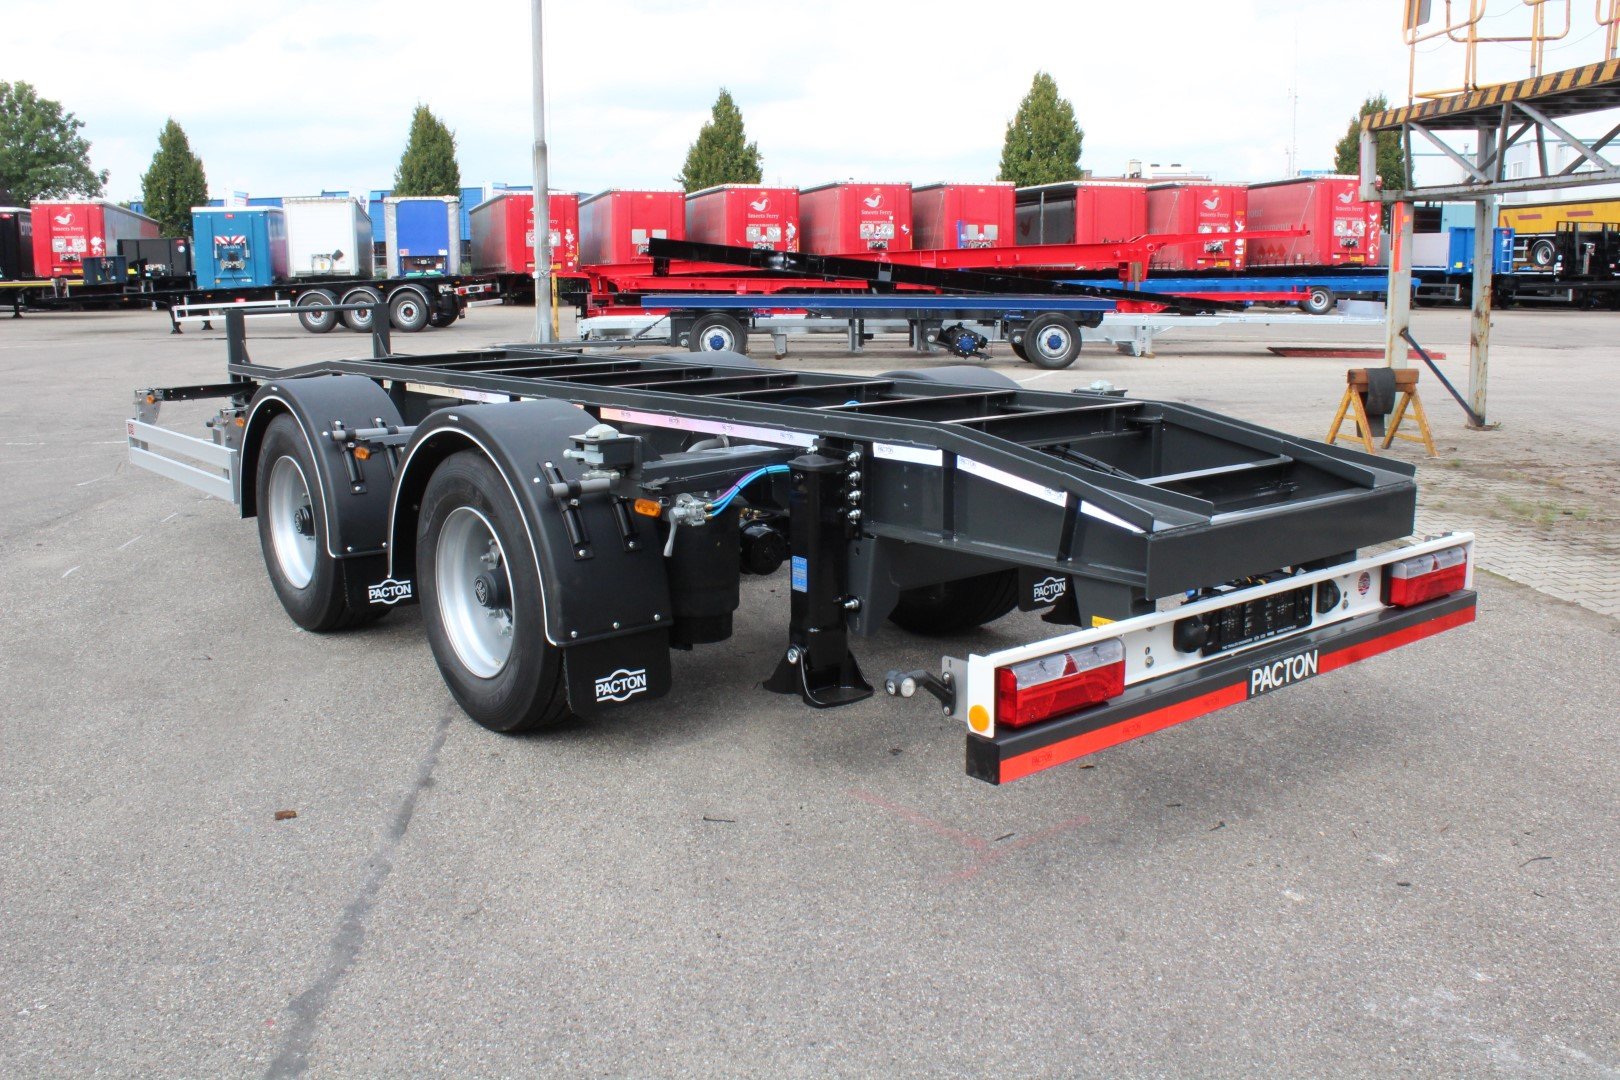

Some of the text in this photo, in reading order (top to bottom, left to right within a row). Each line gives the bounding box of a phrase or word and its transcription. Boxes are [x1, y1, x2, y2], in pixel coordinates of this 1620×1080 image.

[368, 584, 412, 600] PACTON
[1033, 581, 1066, 598] PACTON
[1250, 649, 1319, 695] PACTON
[595, 673, 647, 698] PACTON
